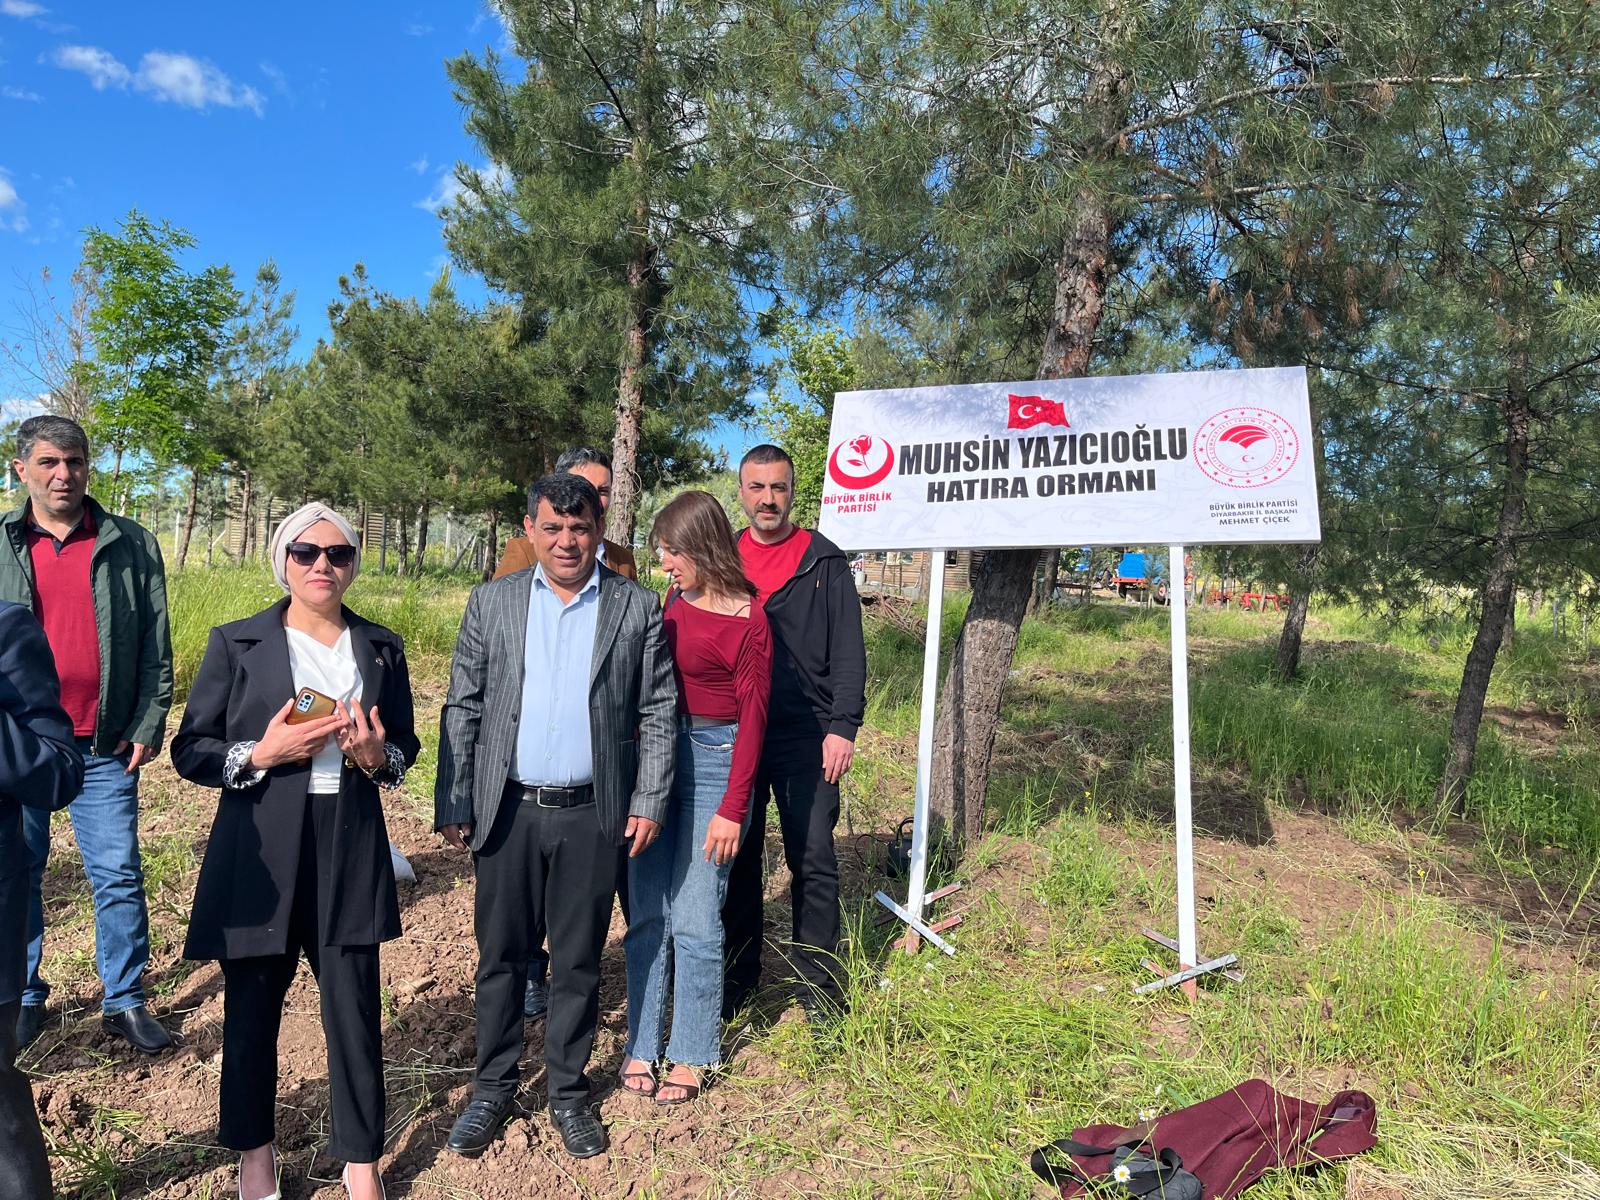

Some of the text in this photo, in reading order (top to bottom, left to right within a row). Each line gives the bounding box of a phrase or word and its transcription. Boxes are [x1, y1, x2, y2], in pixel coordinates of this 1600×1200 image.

[898, 434, 1010, 475] MUHSİN
[1018, 423, 1188, 469] YAZICIOĞLU
[927, 469, 1156, 503] HATIRA ORMANI
[823, 491, 892, 504] BÜYÜK BİRLİK
[837, 502, 876, 513] PARTİSİ
[1209, 500, 1298, 511] BÜYÜK BİRLİK PARTİSİ
[1219, 516, 1290, 526] MEHMET ÇİÇEK
